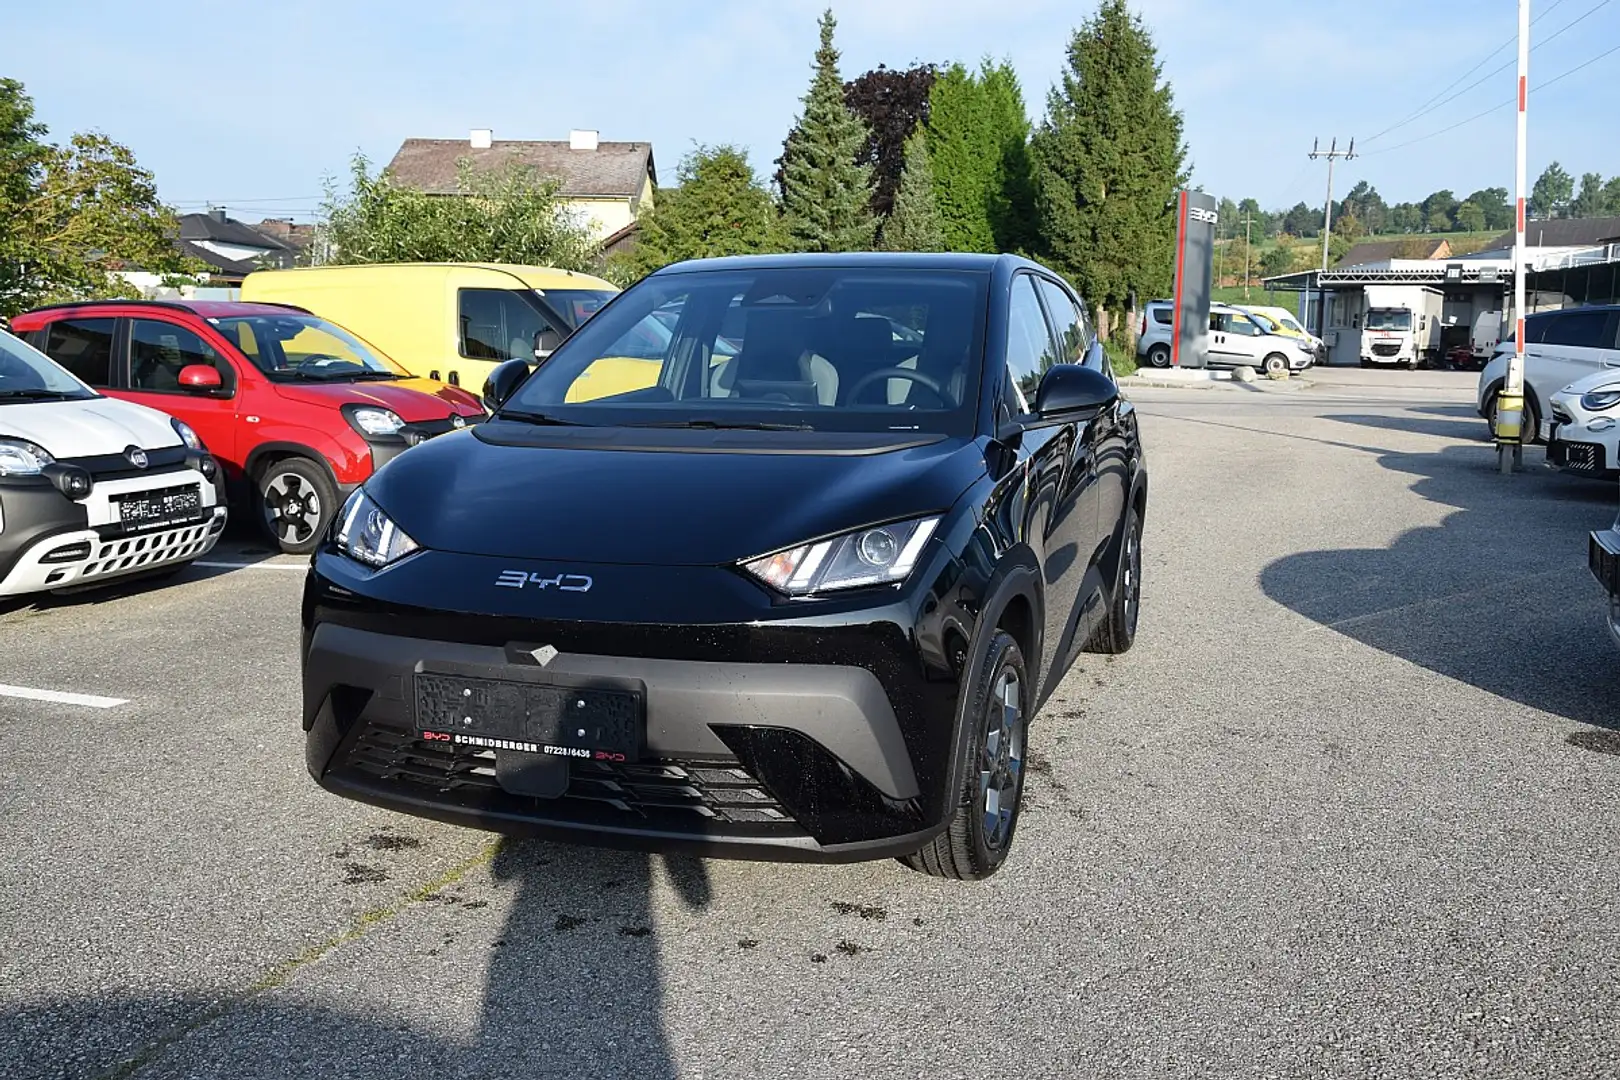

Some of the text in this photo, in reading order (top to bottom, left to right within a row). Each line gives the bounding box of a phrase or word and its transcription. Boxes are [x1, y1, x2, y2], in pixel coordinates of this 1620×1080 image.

[494, 569, 593, 593] BYD
[423, 731, 451, 742] BYD
[454, 734, 538, 753] SCHMIDBERGER
[595, 751, 626, 762] BYD
